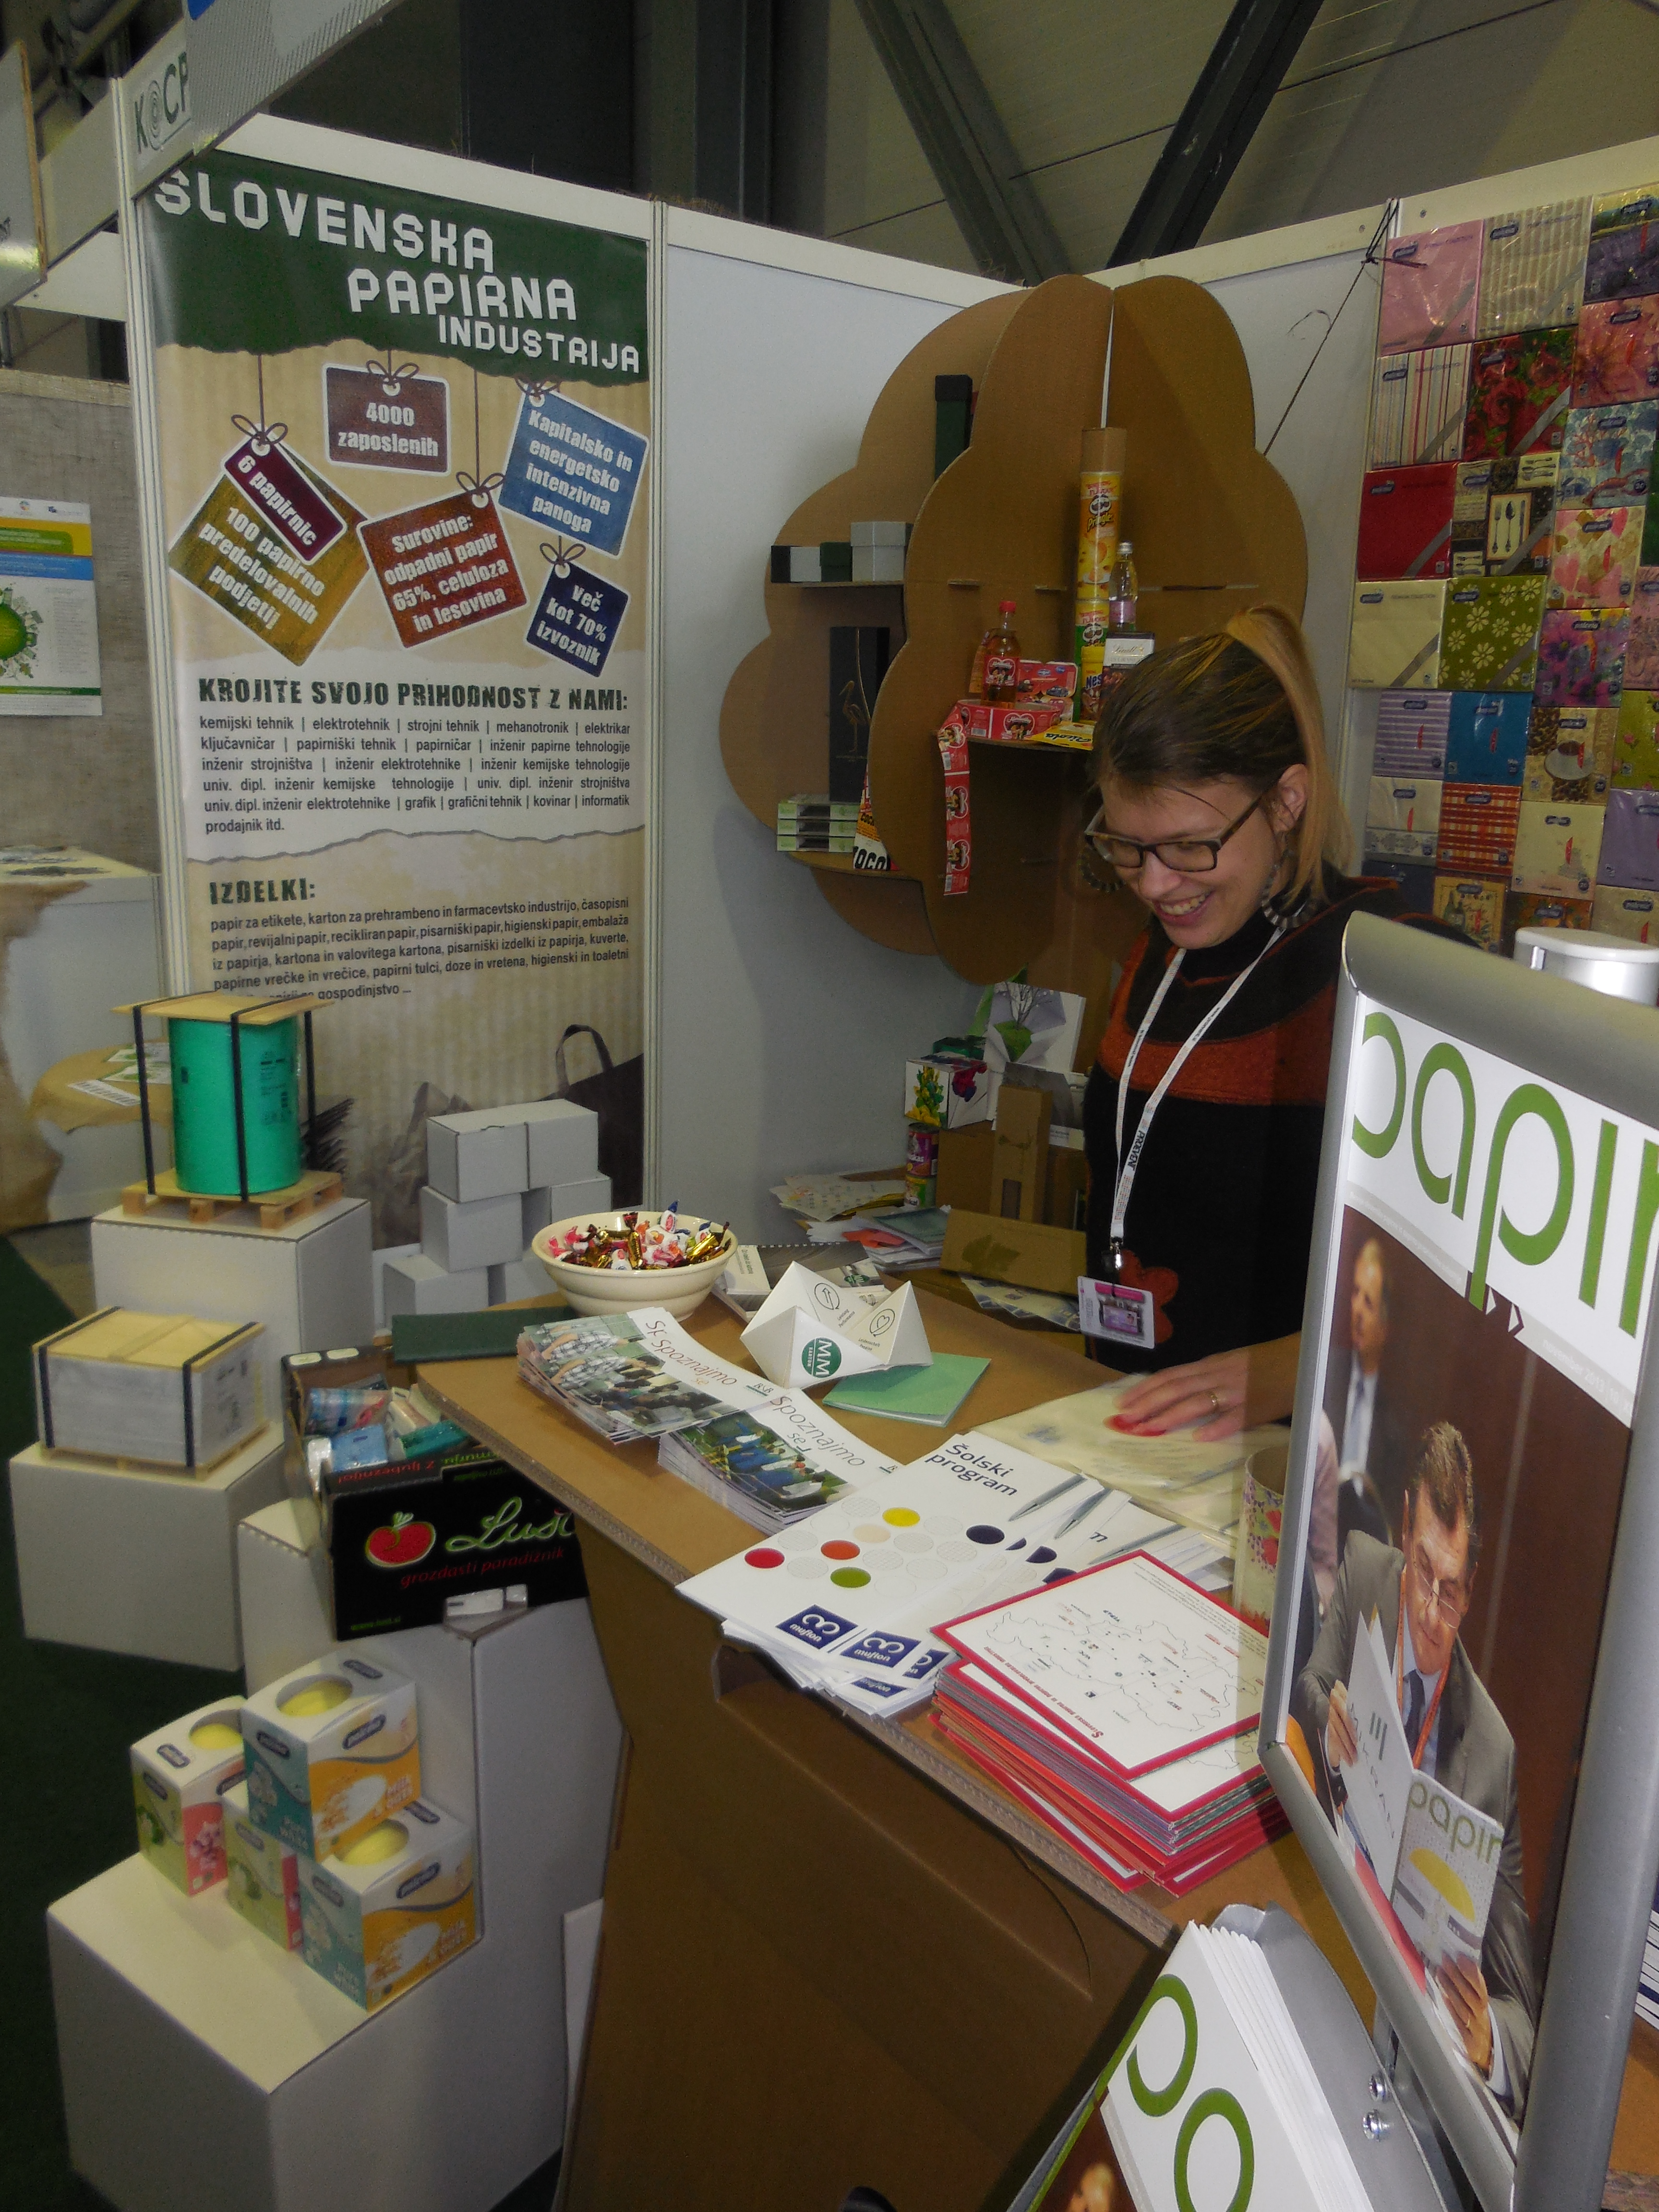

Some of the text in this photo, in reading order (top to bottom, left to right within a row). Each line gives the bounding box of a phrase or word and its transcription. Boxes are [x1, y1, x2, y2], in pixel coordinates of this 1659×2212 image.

[155, 168, 493, 273] SLOVENSKA
[348, 268, 576, 320] PAPIRNA
[439, 314, 639, 373] INDUSTRIJA
[366, 402, 415, 426] 4000
[338, 432, 438, 456] zaposlenih
[529, 410, 633, 473] Kapitalsko in
[529, 440, 620, 493] energetsko
[238, 455, 317, 547] 6 papirnic
[526, 462, 611, 515] intenzivna
[532, 495, 592, 533] panoga
[226, 506, 325, 596] 100 papirno
[384, 532, 498, 585] odpadni papir
[198, 523, 319, 624] predelovalnih
[438, 559, 509, 595] celuloza
[208, 565, 281, 630] podjetij
[412, 588, 506, 633] in lesovina
[571, 585, 604, 612] Več
[546, 597, 607, 642] kot 70%
[536, 620, 601, 666] izvoznik
[199, 677, 628, 710] KROJITE SVOJO PRIHODNOST Z NAMI:
[200, 715, 630, 734] kemijski tehnik elektrotehnik strojni tehnik mehanotronik elektrikar
[201, 736, 630, 754] ključavničar papirniški tehnik papirničar inženir papirne tehnologije
[202, 757, 630, 773] inženir strojništva inženir elektrotehnike inženir kemijske tehnologije
[204, 776, 630, 793] univ. dipl. inženir kemijske tehnologije univ. dipl. inženir strojništva
[204, 794, 629, 813] univ. dipl. inženir elektrotehnike grafik grafični tehnik kovinar informatik
[205, 818, 285, 834] prodajnik itd.
[210, 878, 315, 905] IZDELKI:
[210, 897, 629, 933] papir za etikete, karton za prehrambeno in farmacevtsko industrijo, časopisni
[212, 914, 628, 952] papir, revijalni papir, recikliran papir, pisarniški papir, higienski papir, embalaža
[213, 958, 222, 970] iz
[227, 958, 271, 971] papirja,
[275, 953, 320, 966] kartona
[324, 950, 334, 962] in
[338, 946, 396, 961] valovitega
[399, 944, 445, 956] kartona,
[447, 940, 498, 955] pisarniški
[502, 937, 535, 950] izdelki
[538, 938, 546, 948] iz
[550, 936, 587, 949] papirja,
[214, 949, 628, 991] papirne vrečke in vrečice, papirni tulci, doze in vretena, higienski in toaletni
[318, 984, 399, 1000] gospodinjstvo
[650, 1339, 737, 1386] Spoznajmo
[816, 1339, 833, 1376] MM
[770, 1395, 866, 1467] Spoznajmo
[925, 1453, 1017, 1496] program
[945, 1443, 1014, 1478] Šolski
[790, 1623, 822, 1643] muflon
[854, 1647, 891, 1662] muflon
